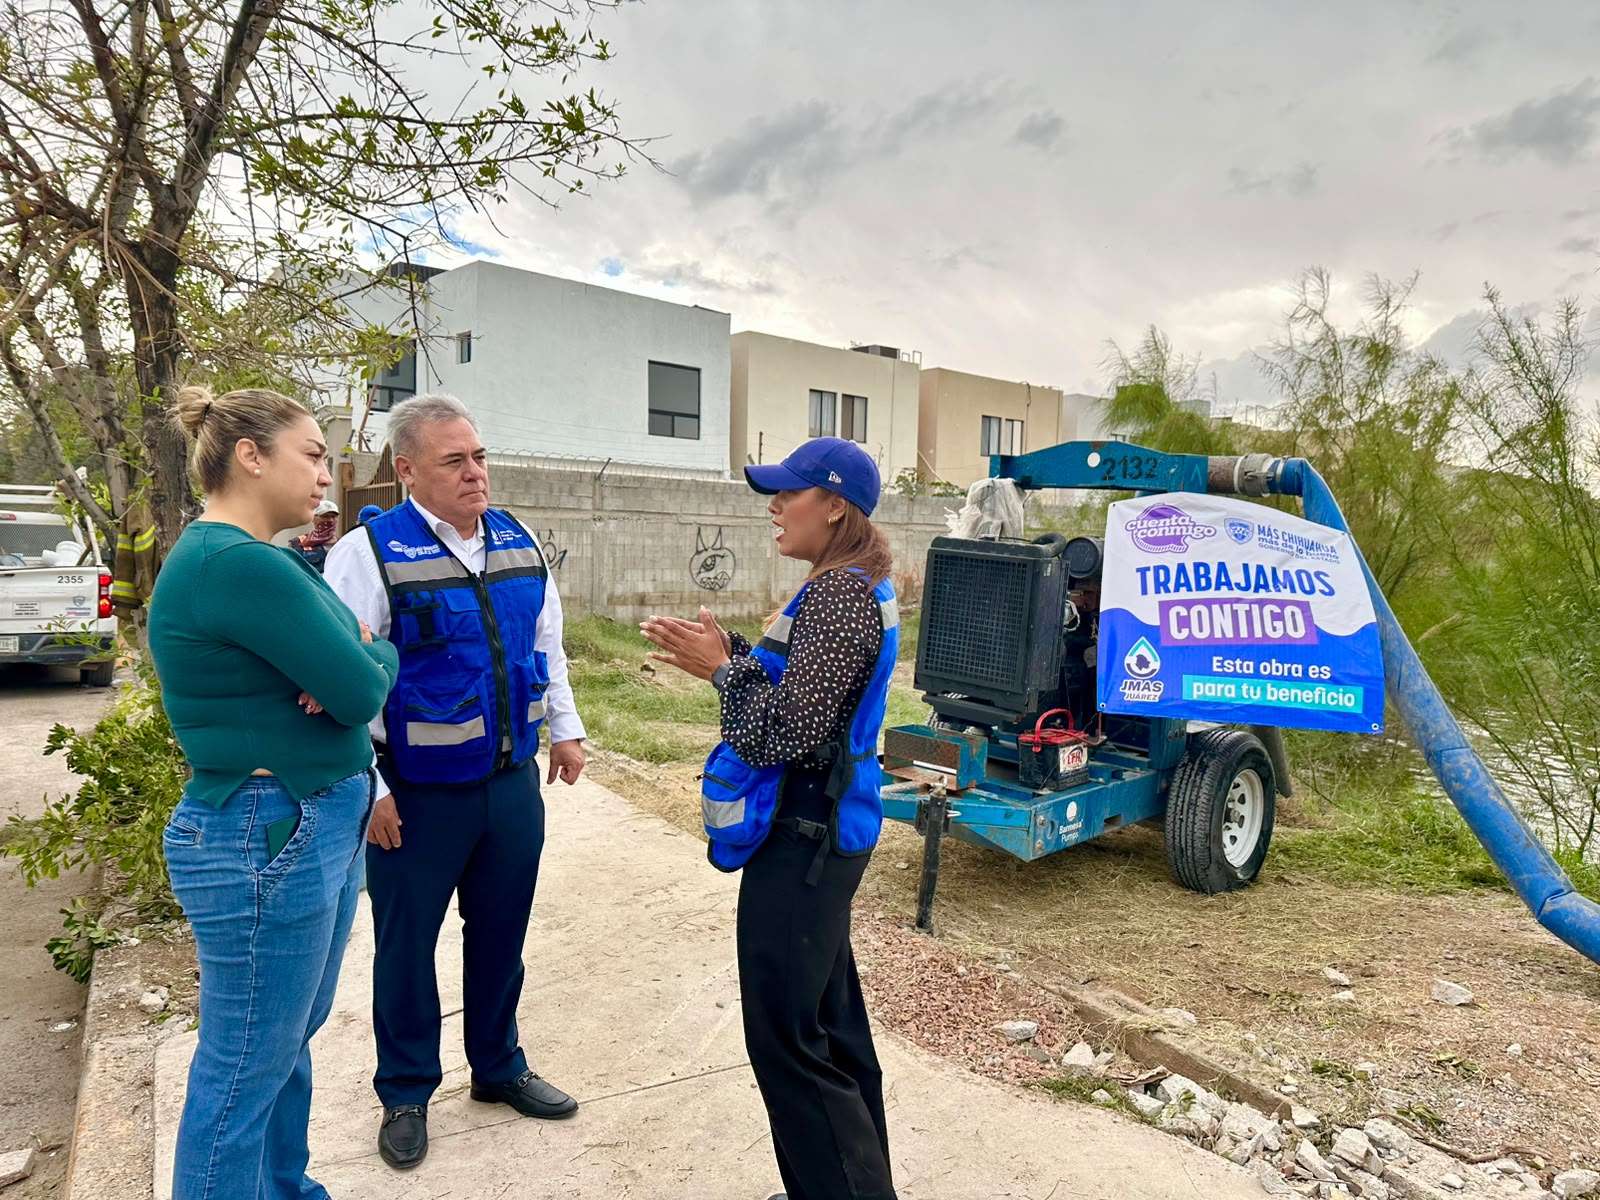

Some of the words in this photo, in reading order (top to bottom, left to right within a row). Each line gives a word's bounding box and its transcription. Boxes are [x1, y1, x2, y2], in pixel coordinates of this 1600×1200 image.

[1103, 455, 1157, 480] 2132
[1126, 514, 1192, 531] cuenta
[1137, 525, 1216, 539] conmigo
[1257, 524, 1280, 540] MÁS
[57, 575, 84, 584] 2355
[1135, 561, 1336, 597] TRABAJAMOS
[1168, 603, 1306, 640] CONTIGO
[1212, 656, 1254, 674] Esta
[1259, 659, 1303, 677] obra
[1308, 664, 1332, 680] es
[1121, 680, 1162, 692] JMAS
[1192, 682, 1236, 699] para
[1241, 682, 1261, 699] tu
[1266, 683, 1355, 707] beneficio
